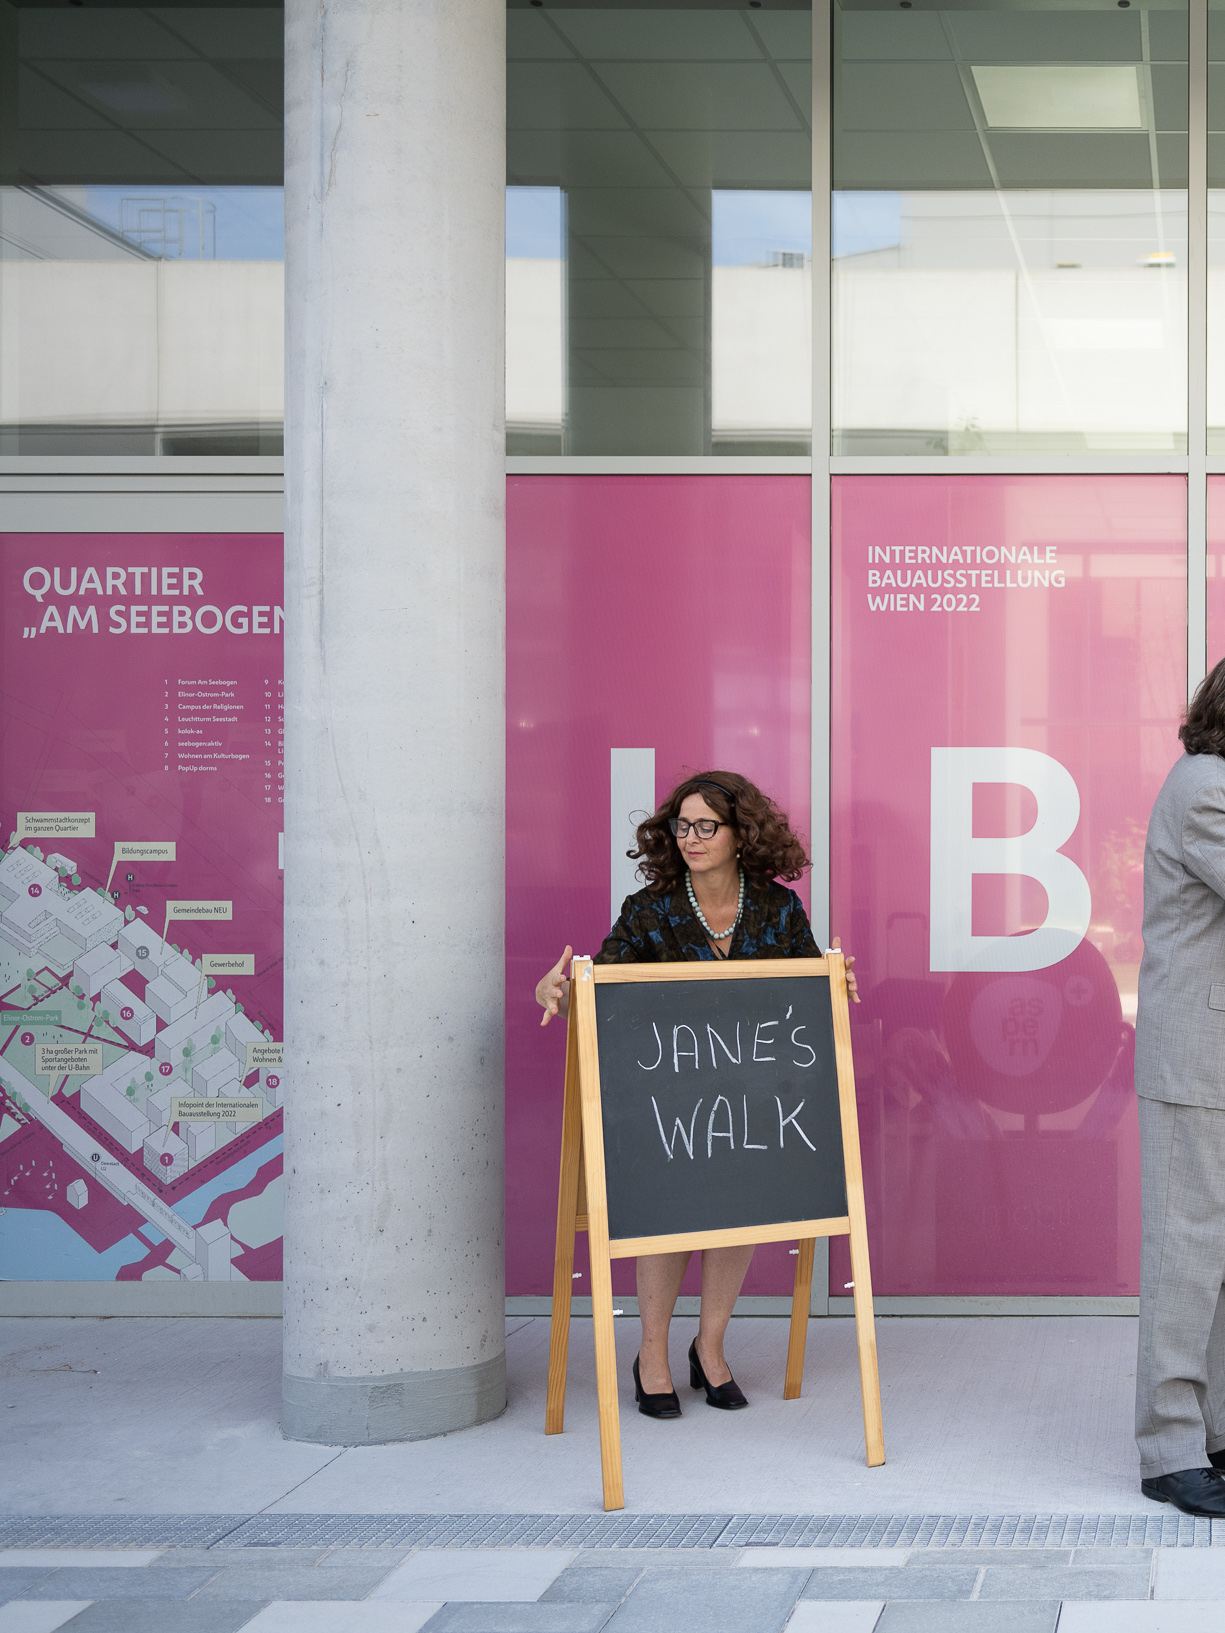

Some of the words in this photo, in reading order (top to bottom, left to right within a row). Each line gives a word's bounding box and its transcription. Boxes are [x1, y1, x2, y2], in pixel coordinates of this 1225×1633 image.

[868, 545, 1057, 564] INTERNATIONALE
[868, 569, 1066, 588] BAUAUSSTELLUNG
[22, 566, 205, 602] QUARTIER
[866, 593, 925, 612] WIEN
[930, 593, 980, 612] 2022
[213, 703, 244, 711] Religionen
[24, 815, 91, 825] Schwammstadtkonzept
[121, 847, 168, 856] Bildungscampus
[30, 887, 40, 895] 14
[173, 906, 212, 914] Gemeindebau
[138, 949, 147, 957] 15
[209, 960, 245, 968] Gewerbehof
[122, 1009, 131, 1018] 16
[25, 1035, 31, 1043] 2
[637, 1004, 816, 1073] JANE'S
[41, 1047, 46, 1055] 3
[46, 1047, 54, 1055] ha
[54, 1047, 73, 1056] großer
[74, 1047, 88, 1055] Park
[88, 1047, 98, 1055] mit
[252, 1047, 280, 1055] Angebote
[41, 1056, 88, 1064] Sportangeboten
[161, 1065, 170, 1073] 17
[268, 1078, 278, 1086] 18
[178, 1101, 204, 1109] Infopoint
[178, 1110, 220, 1119] Bauausstellung
[651, 1094, 817, 1162] WALK
